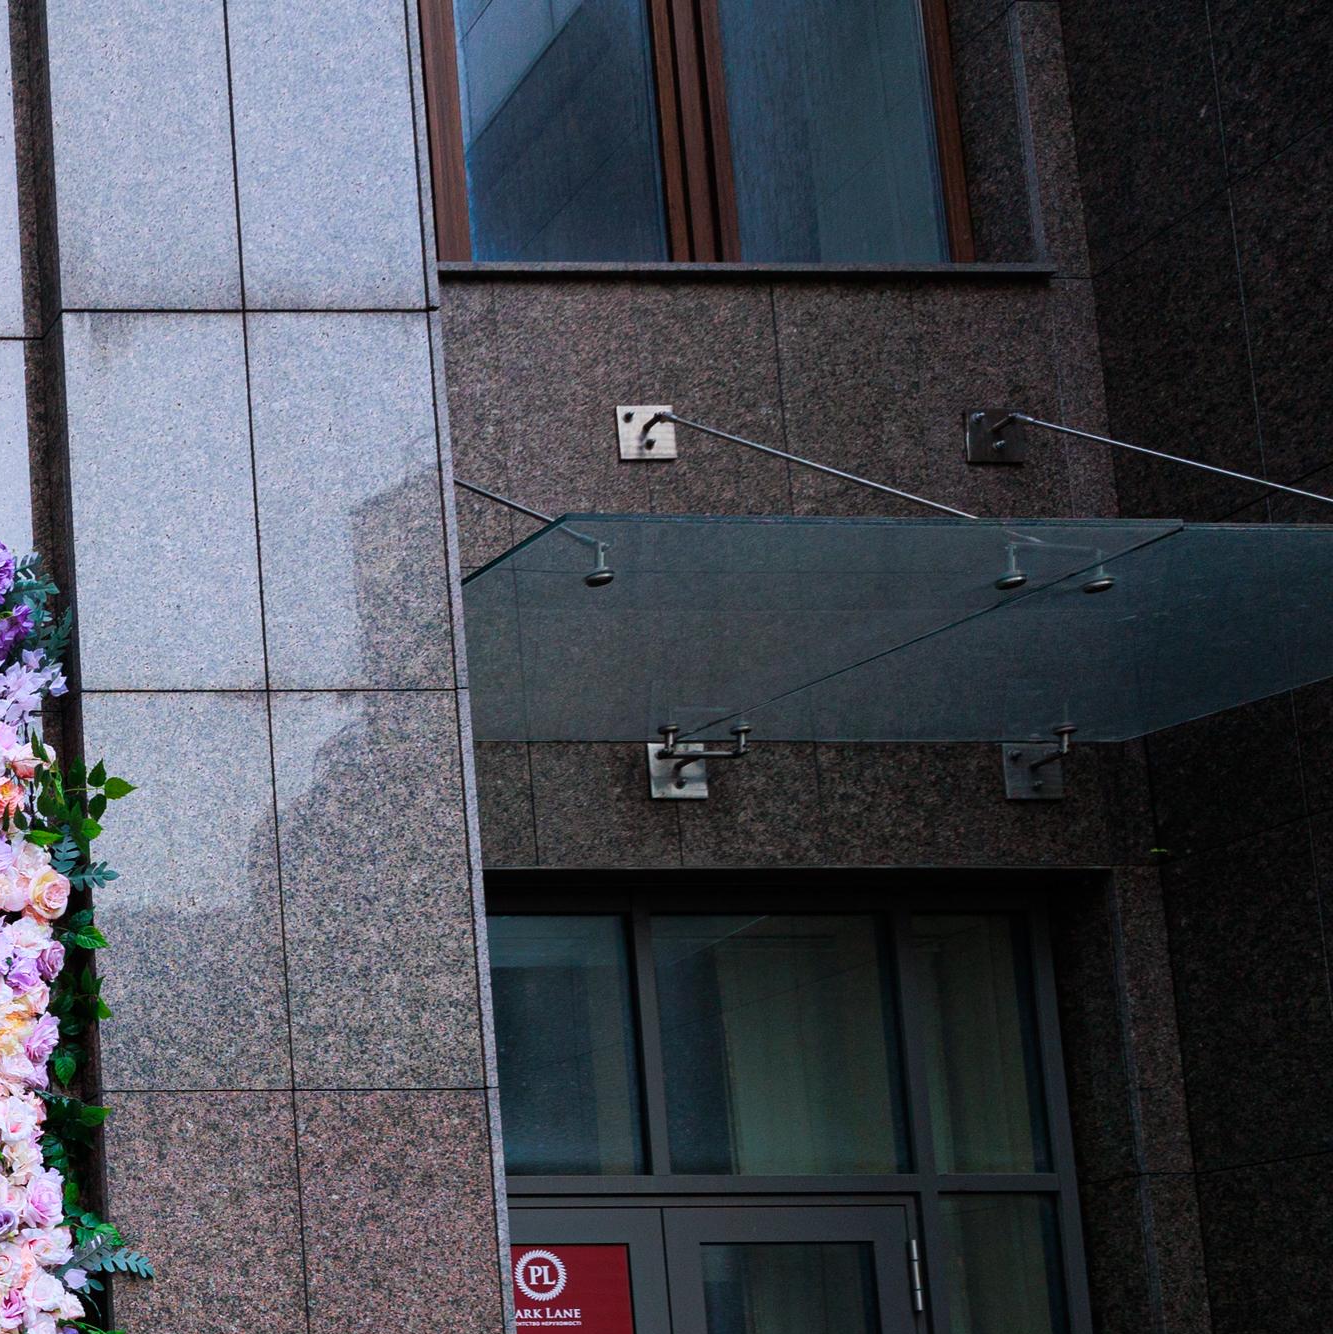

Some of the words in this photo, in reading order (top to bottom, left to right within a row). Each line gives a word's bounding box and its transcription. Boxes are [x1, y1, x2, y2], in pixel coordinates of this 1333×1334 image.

[527, 1265, 557, 1286] PL
[515, 1308, 543, 1319] ARK
[545, 1307, 582, 1319] LANE
